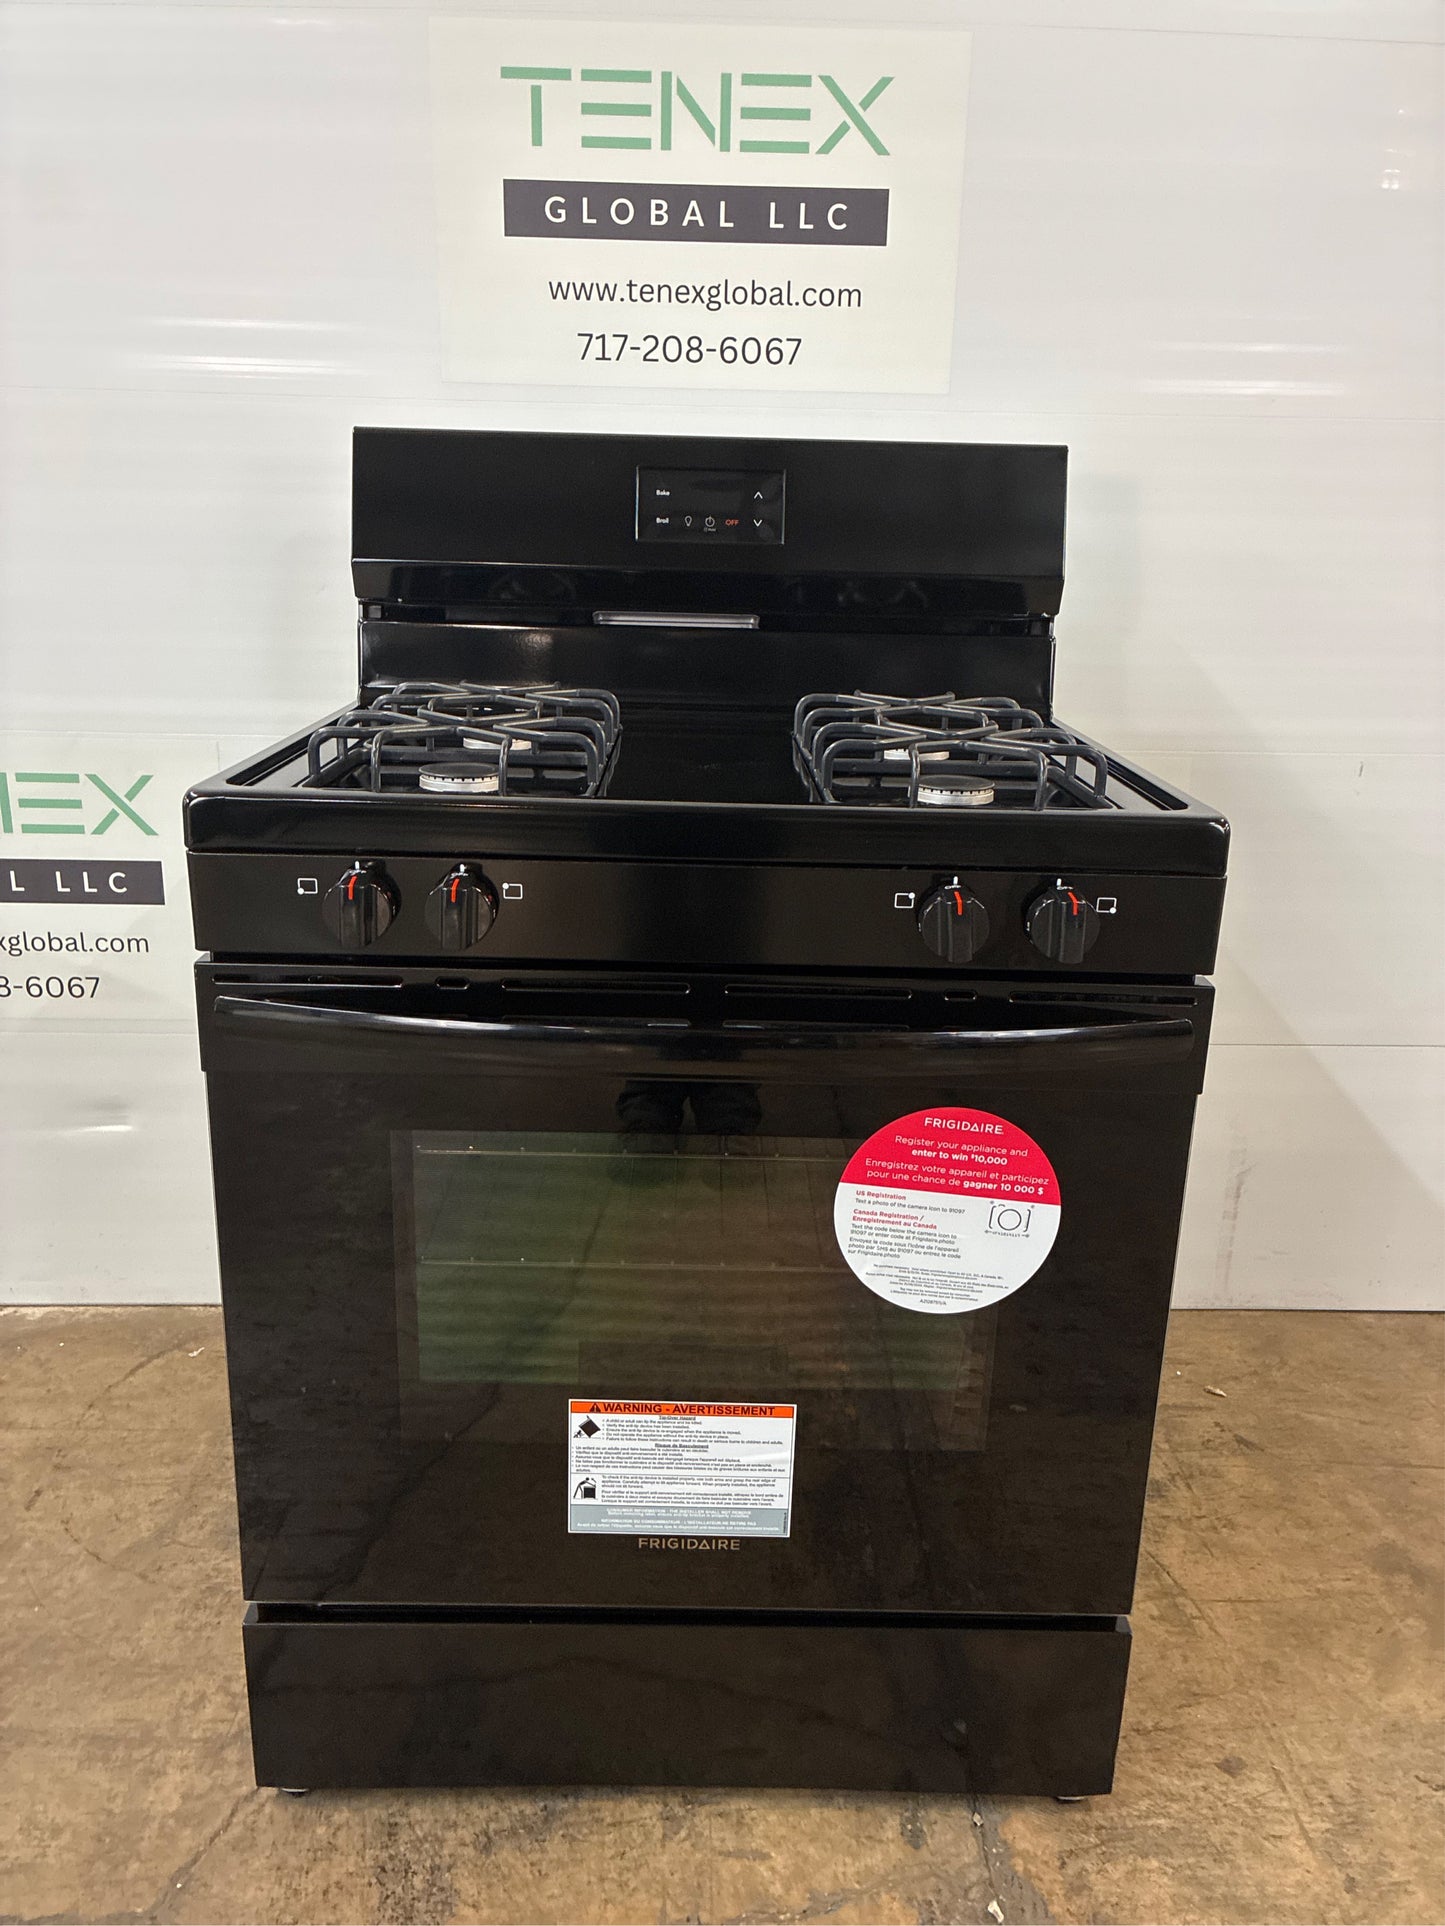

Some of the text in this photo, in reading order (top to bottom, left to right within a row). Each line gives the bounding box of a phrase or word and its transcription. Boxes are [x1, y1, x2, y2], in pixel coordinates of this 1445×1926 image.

[501, 66, 895, 155] TENEX
[544, 196, 849, 231] GLOBAL LLC
[548, 279, 863, 311] www.tenexglobal.com
[577, 332, 803, 366] 717-208-6067
[656, 489, 670, 497] Bake
[55, 870, 128, 893] LLC
[924, 1117, 1004, 1135] FRIGIDAIRE
[895, 1135, 1028, 1156] Register your appliance and
[912, 1149, 937, 1158] enter
[951, 1152, 968, 1161] win
[971, 1154, 1008, 1167] $10,000
[865, 1158, 919, 1172] Enregistrez
[921, 1165, 946, 1174] votre
[948, 1167, 987, 1179] appareil
[1001, 1173, 1050, 1186] participez
[867, 1170, 1044, 1195] pour une chance de gagner 10 000 $
[866, 1191, 906, 1201] Registration
[852, 1216, 902, 1227] Enregistrement
[879, 1211, 919, 1221] Registration
[604, 1403, 662, 1413] WARNING
[672, 1405, 775, 1416] AVERTISSEMENT
[638, 1537, 741, 1551] FRIGIDAIRE
